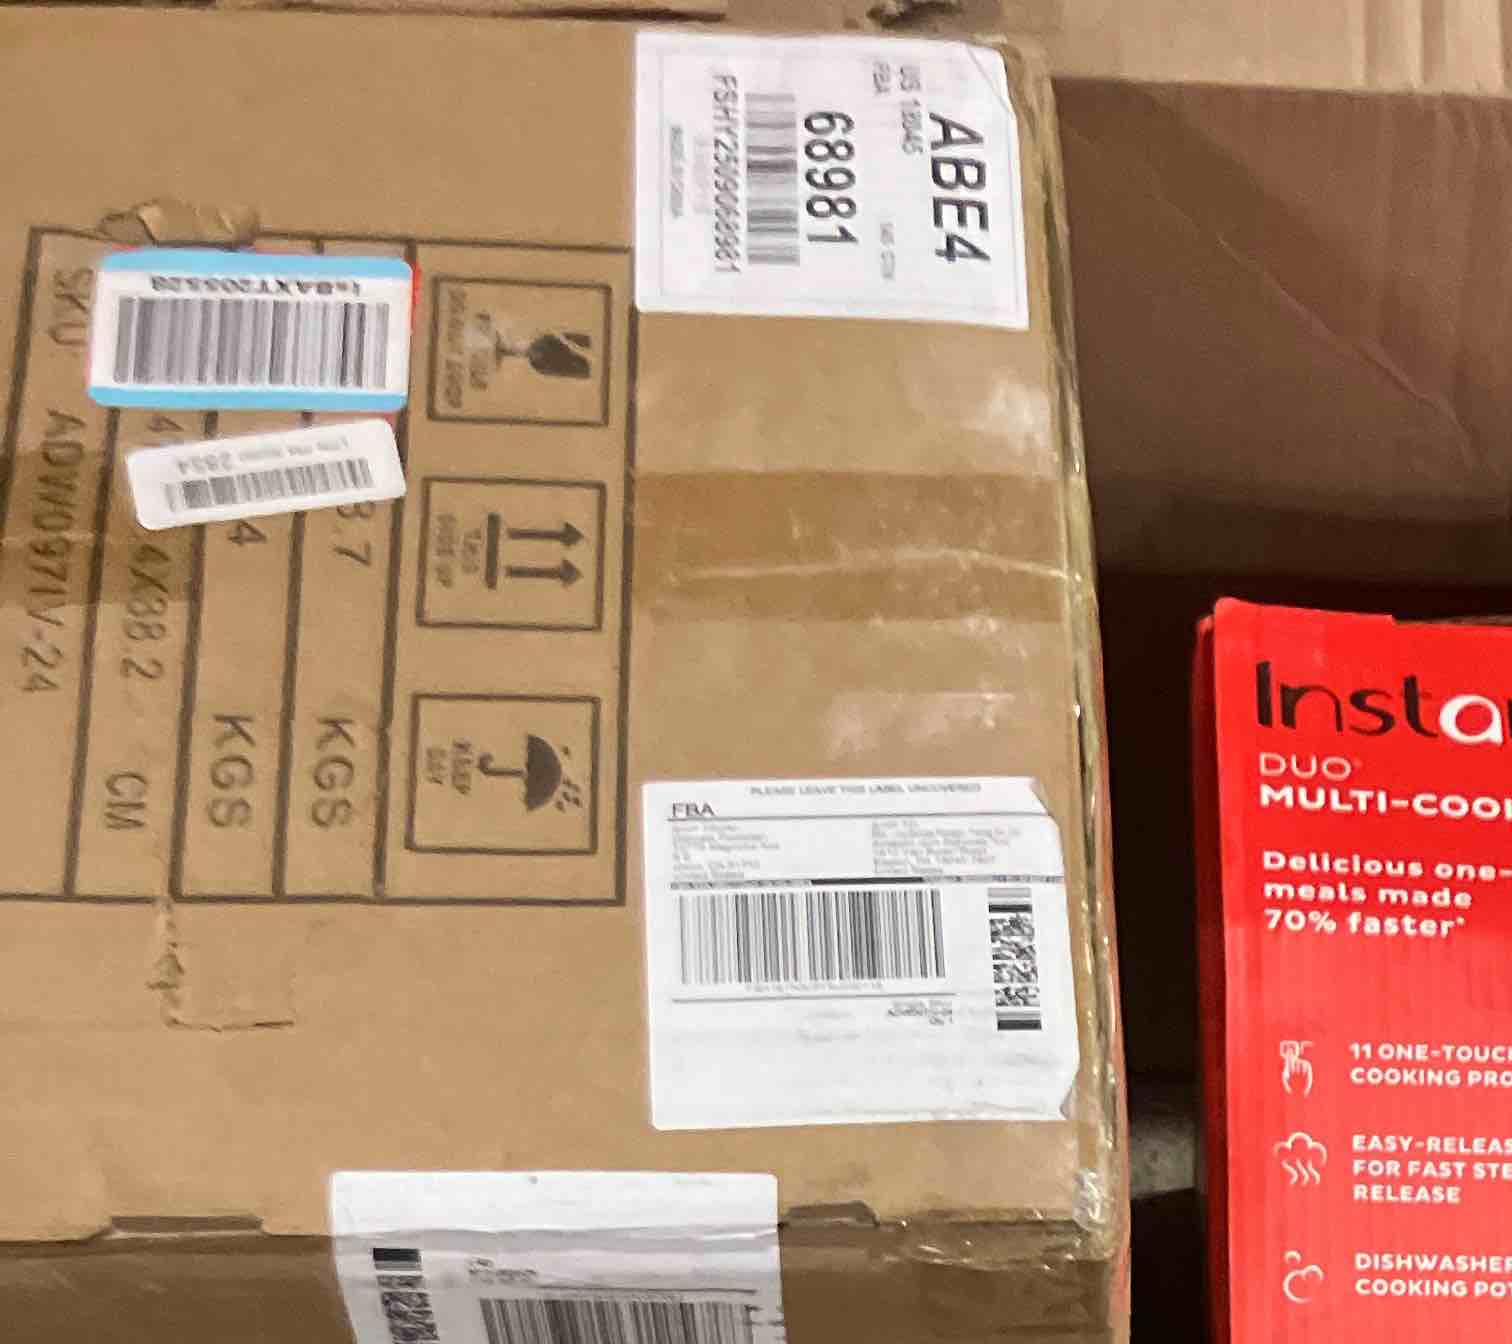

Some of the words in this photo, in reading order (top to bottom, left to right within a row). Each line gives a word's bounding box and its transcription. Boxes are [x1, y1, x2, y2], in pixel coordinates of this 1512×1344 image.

[803, 110, 859, 247] 68981
[929, 112, 992, 264] ABE4
[208, 712, 256, 830] KGS
[310, 717, 355, 831] KGS
[1258, 752, 1353, 779] DUO
[671, 802, 716, 817] FBA
[1262, 850, 1424, 879] Delicious
[1263, 880, 1368, 904] meals
[1378, 885, 1473, 909] made
[1264, 908, 1337, 934] 70%
[1350, 1067, 1461, 1088] COOKING
[1352, 1160, 1401, 1178] FOR
[1407, 1161, 1467, 1179] FAST
[1352, 1184, 1461, 1204] RELEASE
[1355, 1278, 1468, 1299] COOKING
